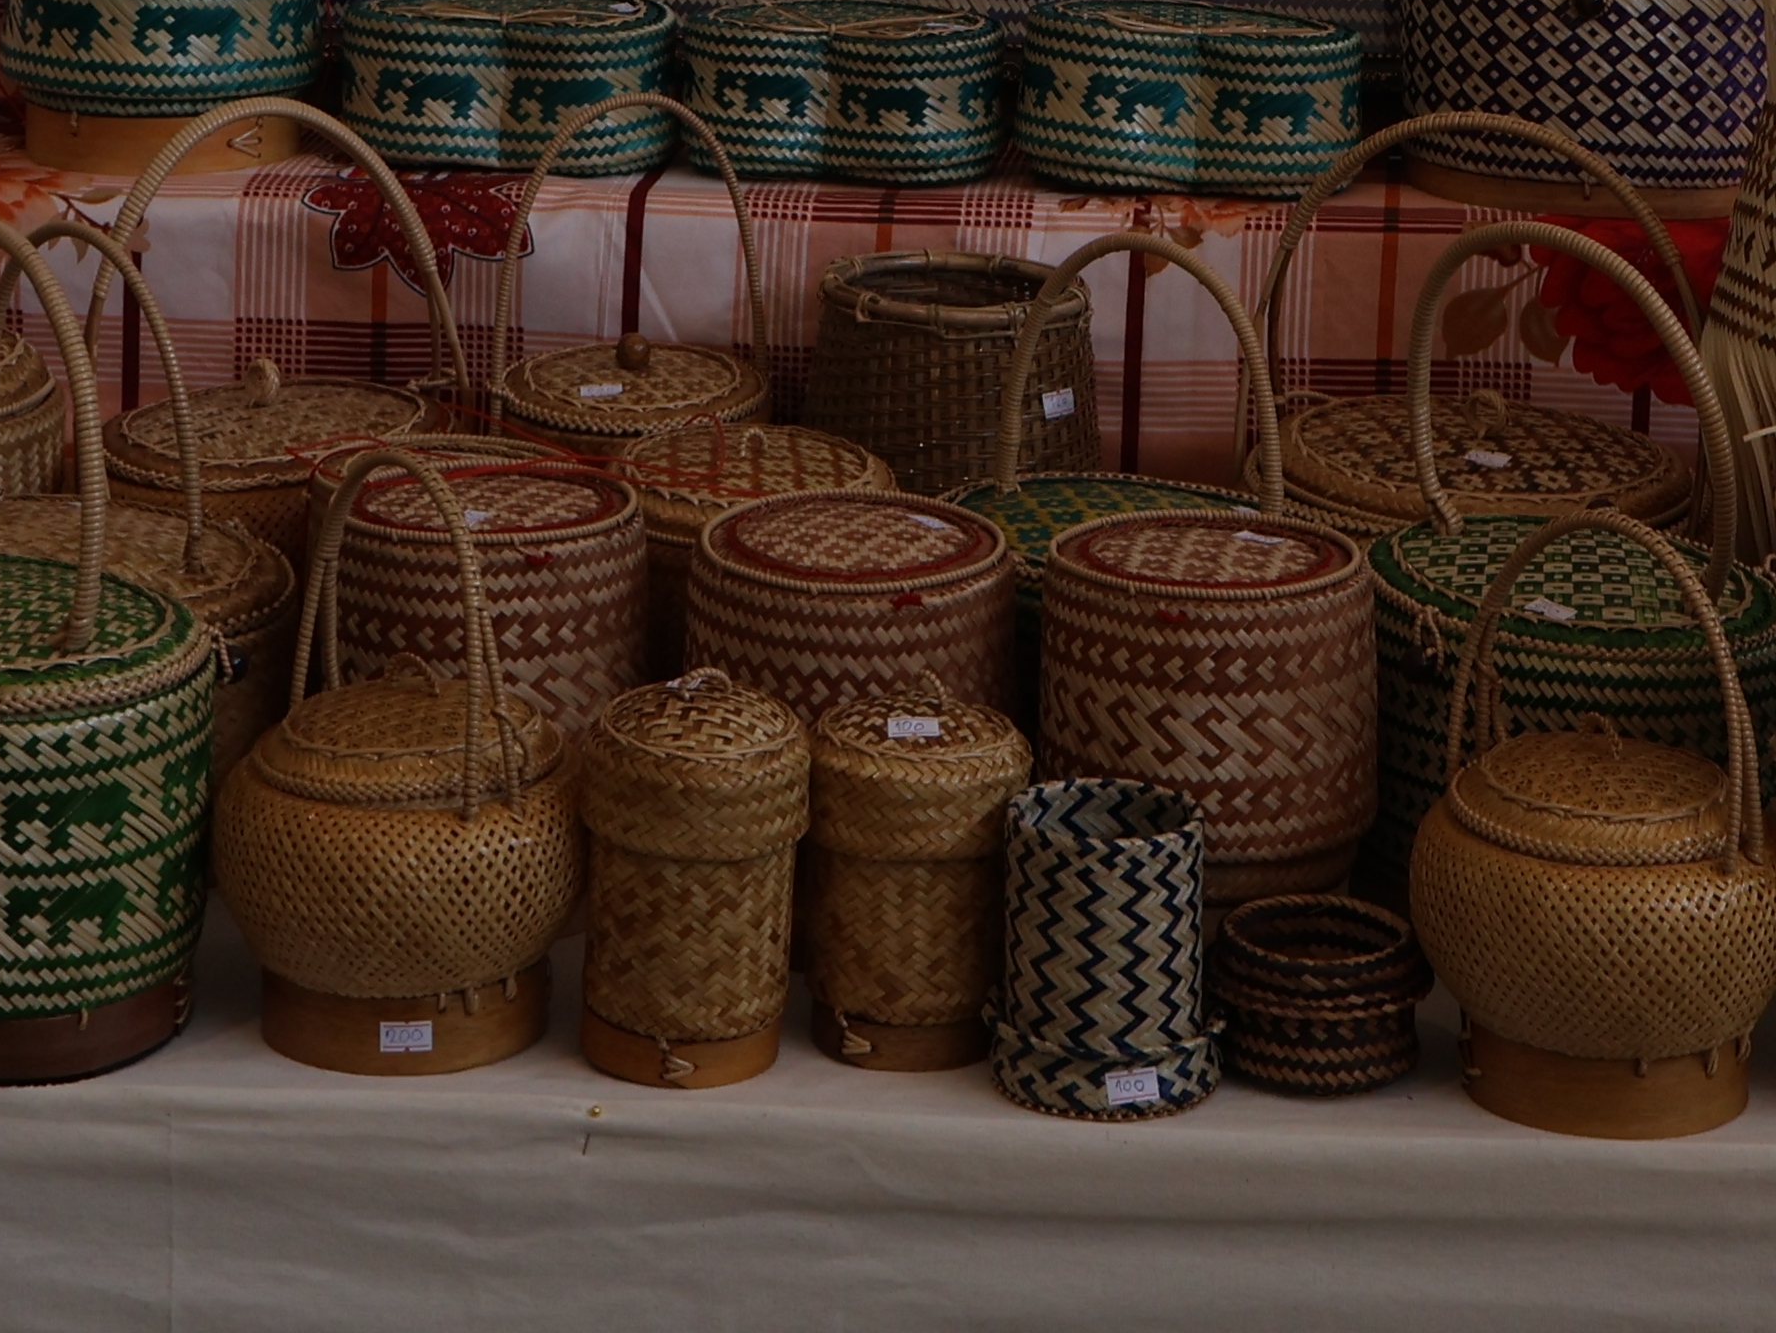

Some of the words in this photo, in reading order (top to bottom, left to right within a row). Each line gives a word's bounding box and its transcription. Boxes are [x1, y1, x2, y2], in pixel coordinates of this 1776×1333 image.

[895, 720, 926, 732] 100
[385, 1027, 424, 1044] 200
[1114, 1077, 1146, 1093] 100
